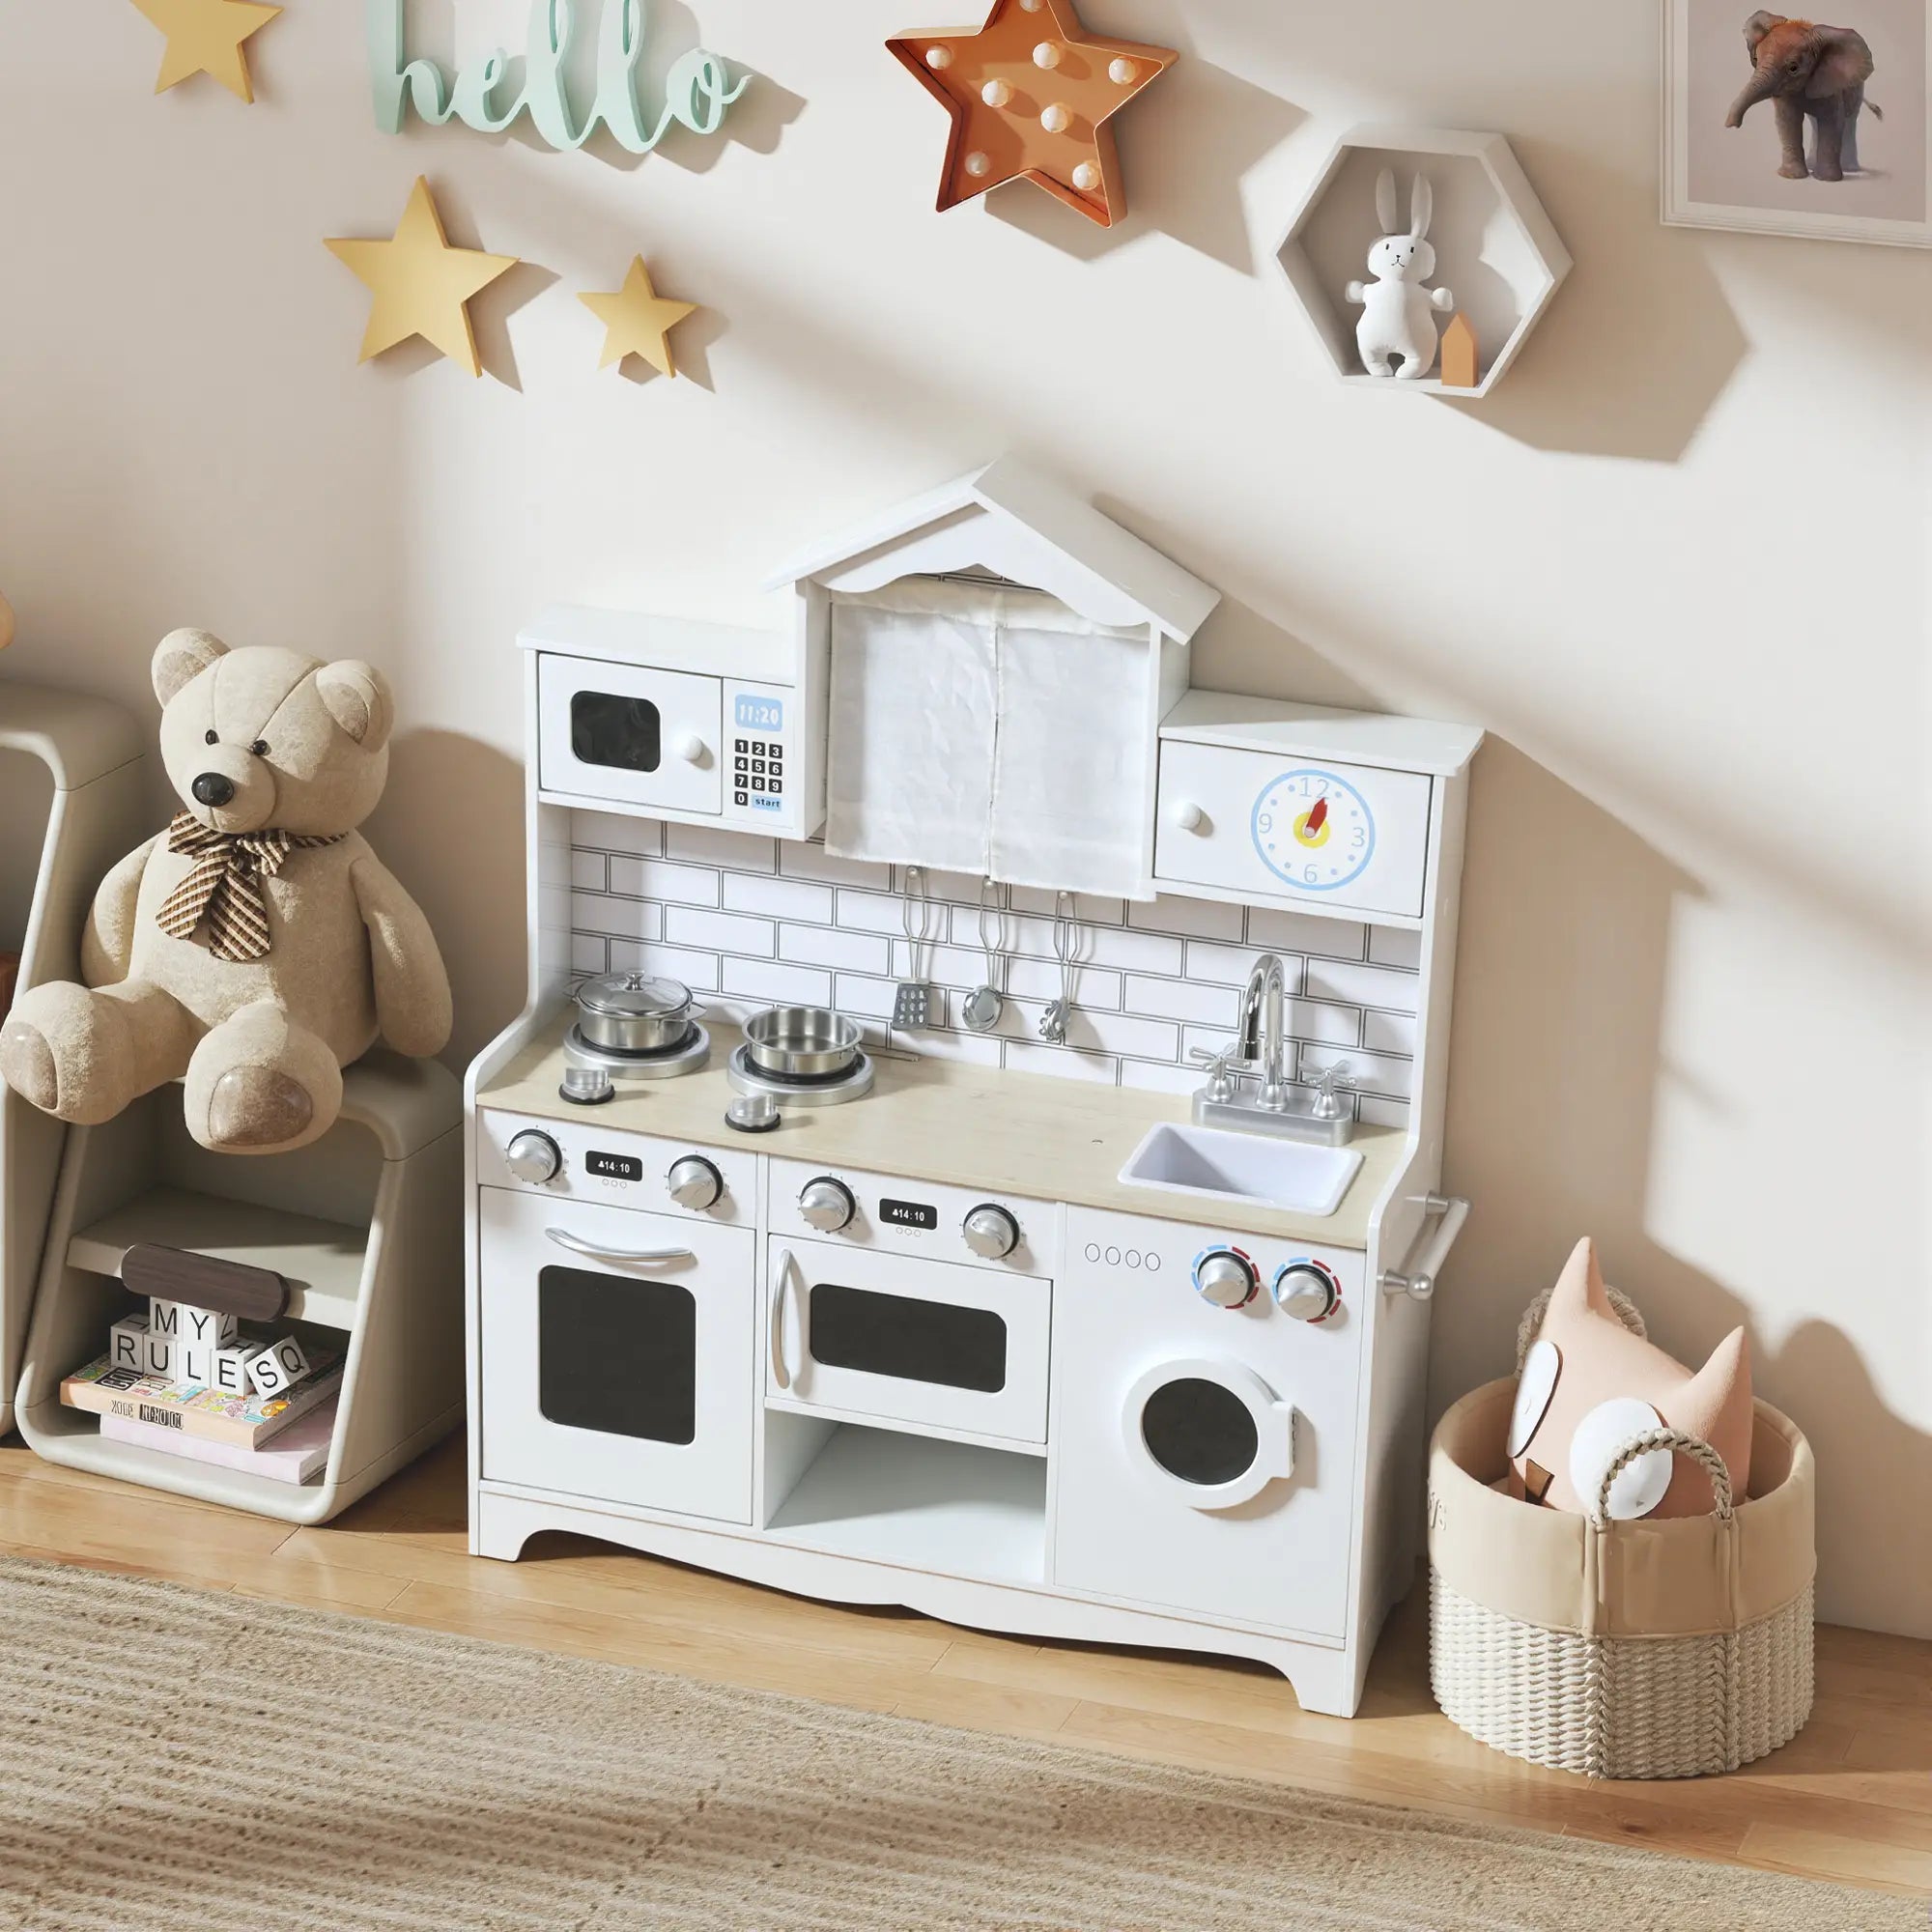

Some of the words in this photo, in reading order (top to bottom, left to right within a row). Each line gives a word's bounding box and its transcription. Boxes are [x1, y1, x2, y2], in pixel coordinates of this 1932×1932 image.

[366, 0, 753, 154] hello
[738, 703, 780, 725] 11:20
[1299, 777, 1330, 800] 12
[754, 797, 781, 809] start
[1259, 812, 1272, 834] 9
[1350, 826, 1365, 848] 3
[1303, 863, 1318, 884] 6
[155, 1303, 210, 1341] MY
[117, 1333, 279, 1389] RULES
[280, 1345, 304, 1374] Q
